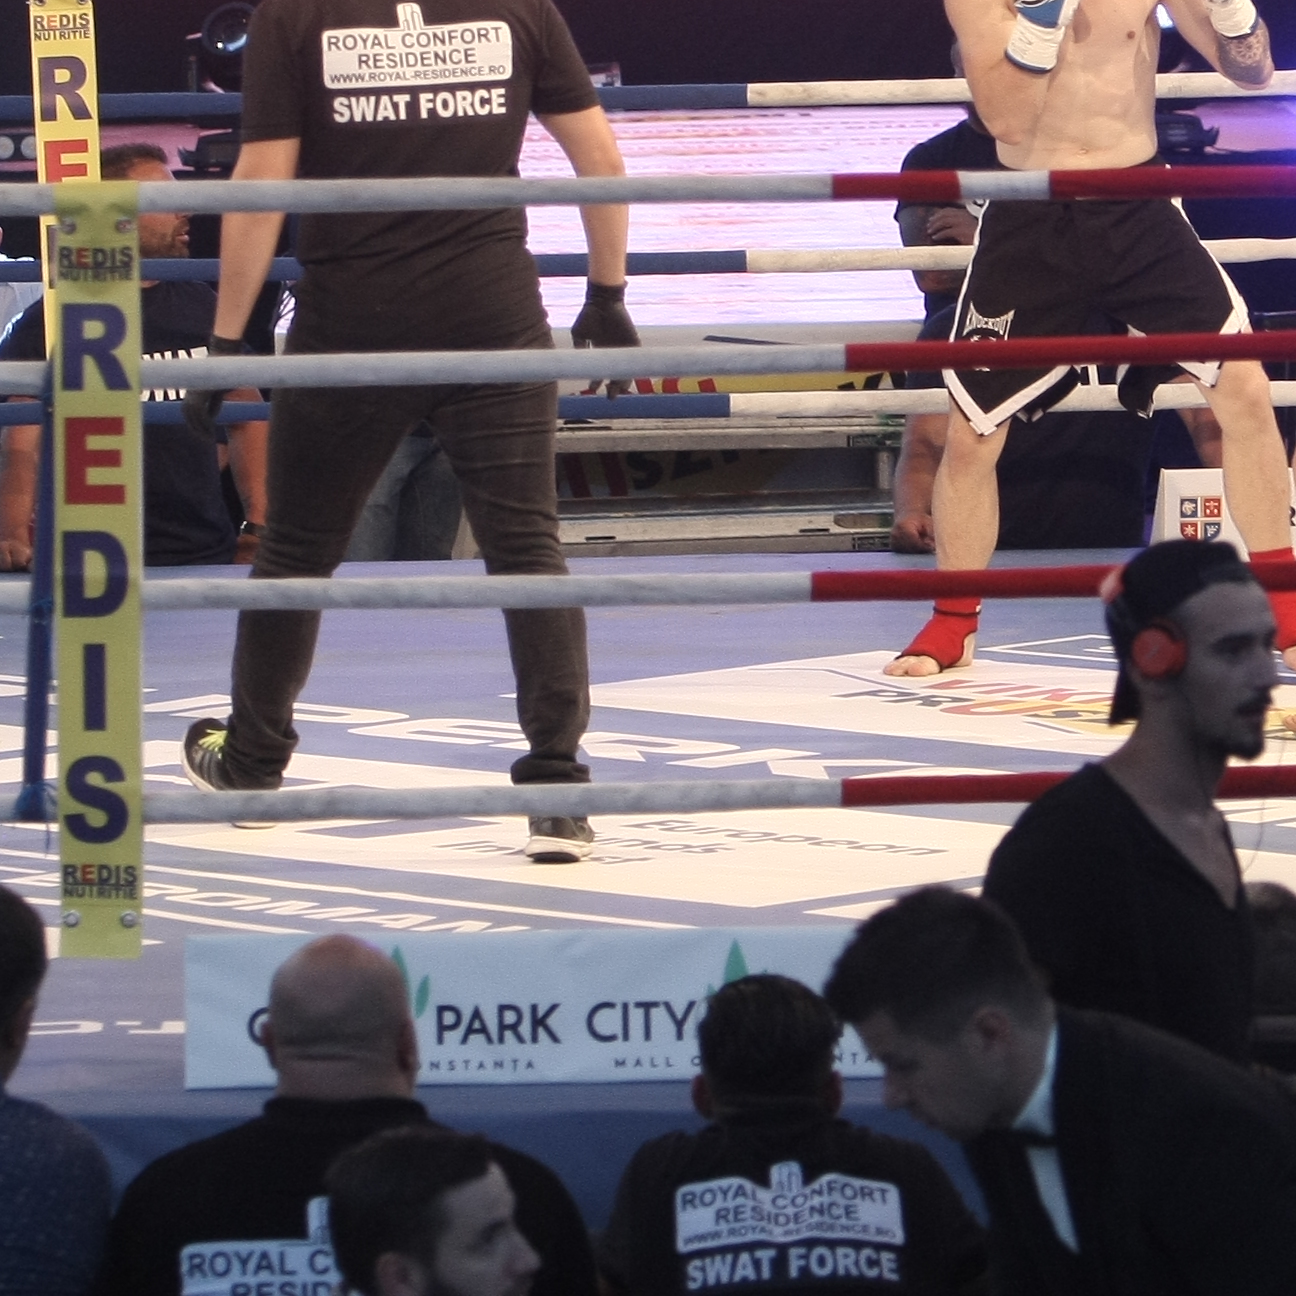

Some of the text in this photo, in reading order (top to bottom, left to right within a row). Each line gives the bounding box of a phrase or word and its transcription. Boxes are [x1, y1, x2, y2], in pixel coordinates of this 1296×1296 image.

[33, 13, 90, 29] REDIS
[34, 30, 90, 41] NUTRITIE
[327, 27, 502, 52] ROYAL CONFORT
[358, 48, 477, 70] RESIDENCE
[330, 65, 506, 84] WWW.ROYAL-RESIDENCE.RO
[333, 88, 507, 124] SWAT FORCE
[59, 245, 133, 268] REDIS
[61, 303, 133, 844] REDIS
[620, 818, 950, 857] European
[63, 864, 137, 886] REDIS
[63, 885, 137, 900] NUTRITIE
[435, 1000, 697, 1046] PARK CITY
[614, 1056, 675, 1070] MALL
[680, 1179, 890, 1212] ROYAL CONFORT
[714, 1203, 860, 1227] RESIDENCE
[188, 1250, 297, 1279] ROYAL
[687, 1245, 900, 1291] SWAT FORCE
